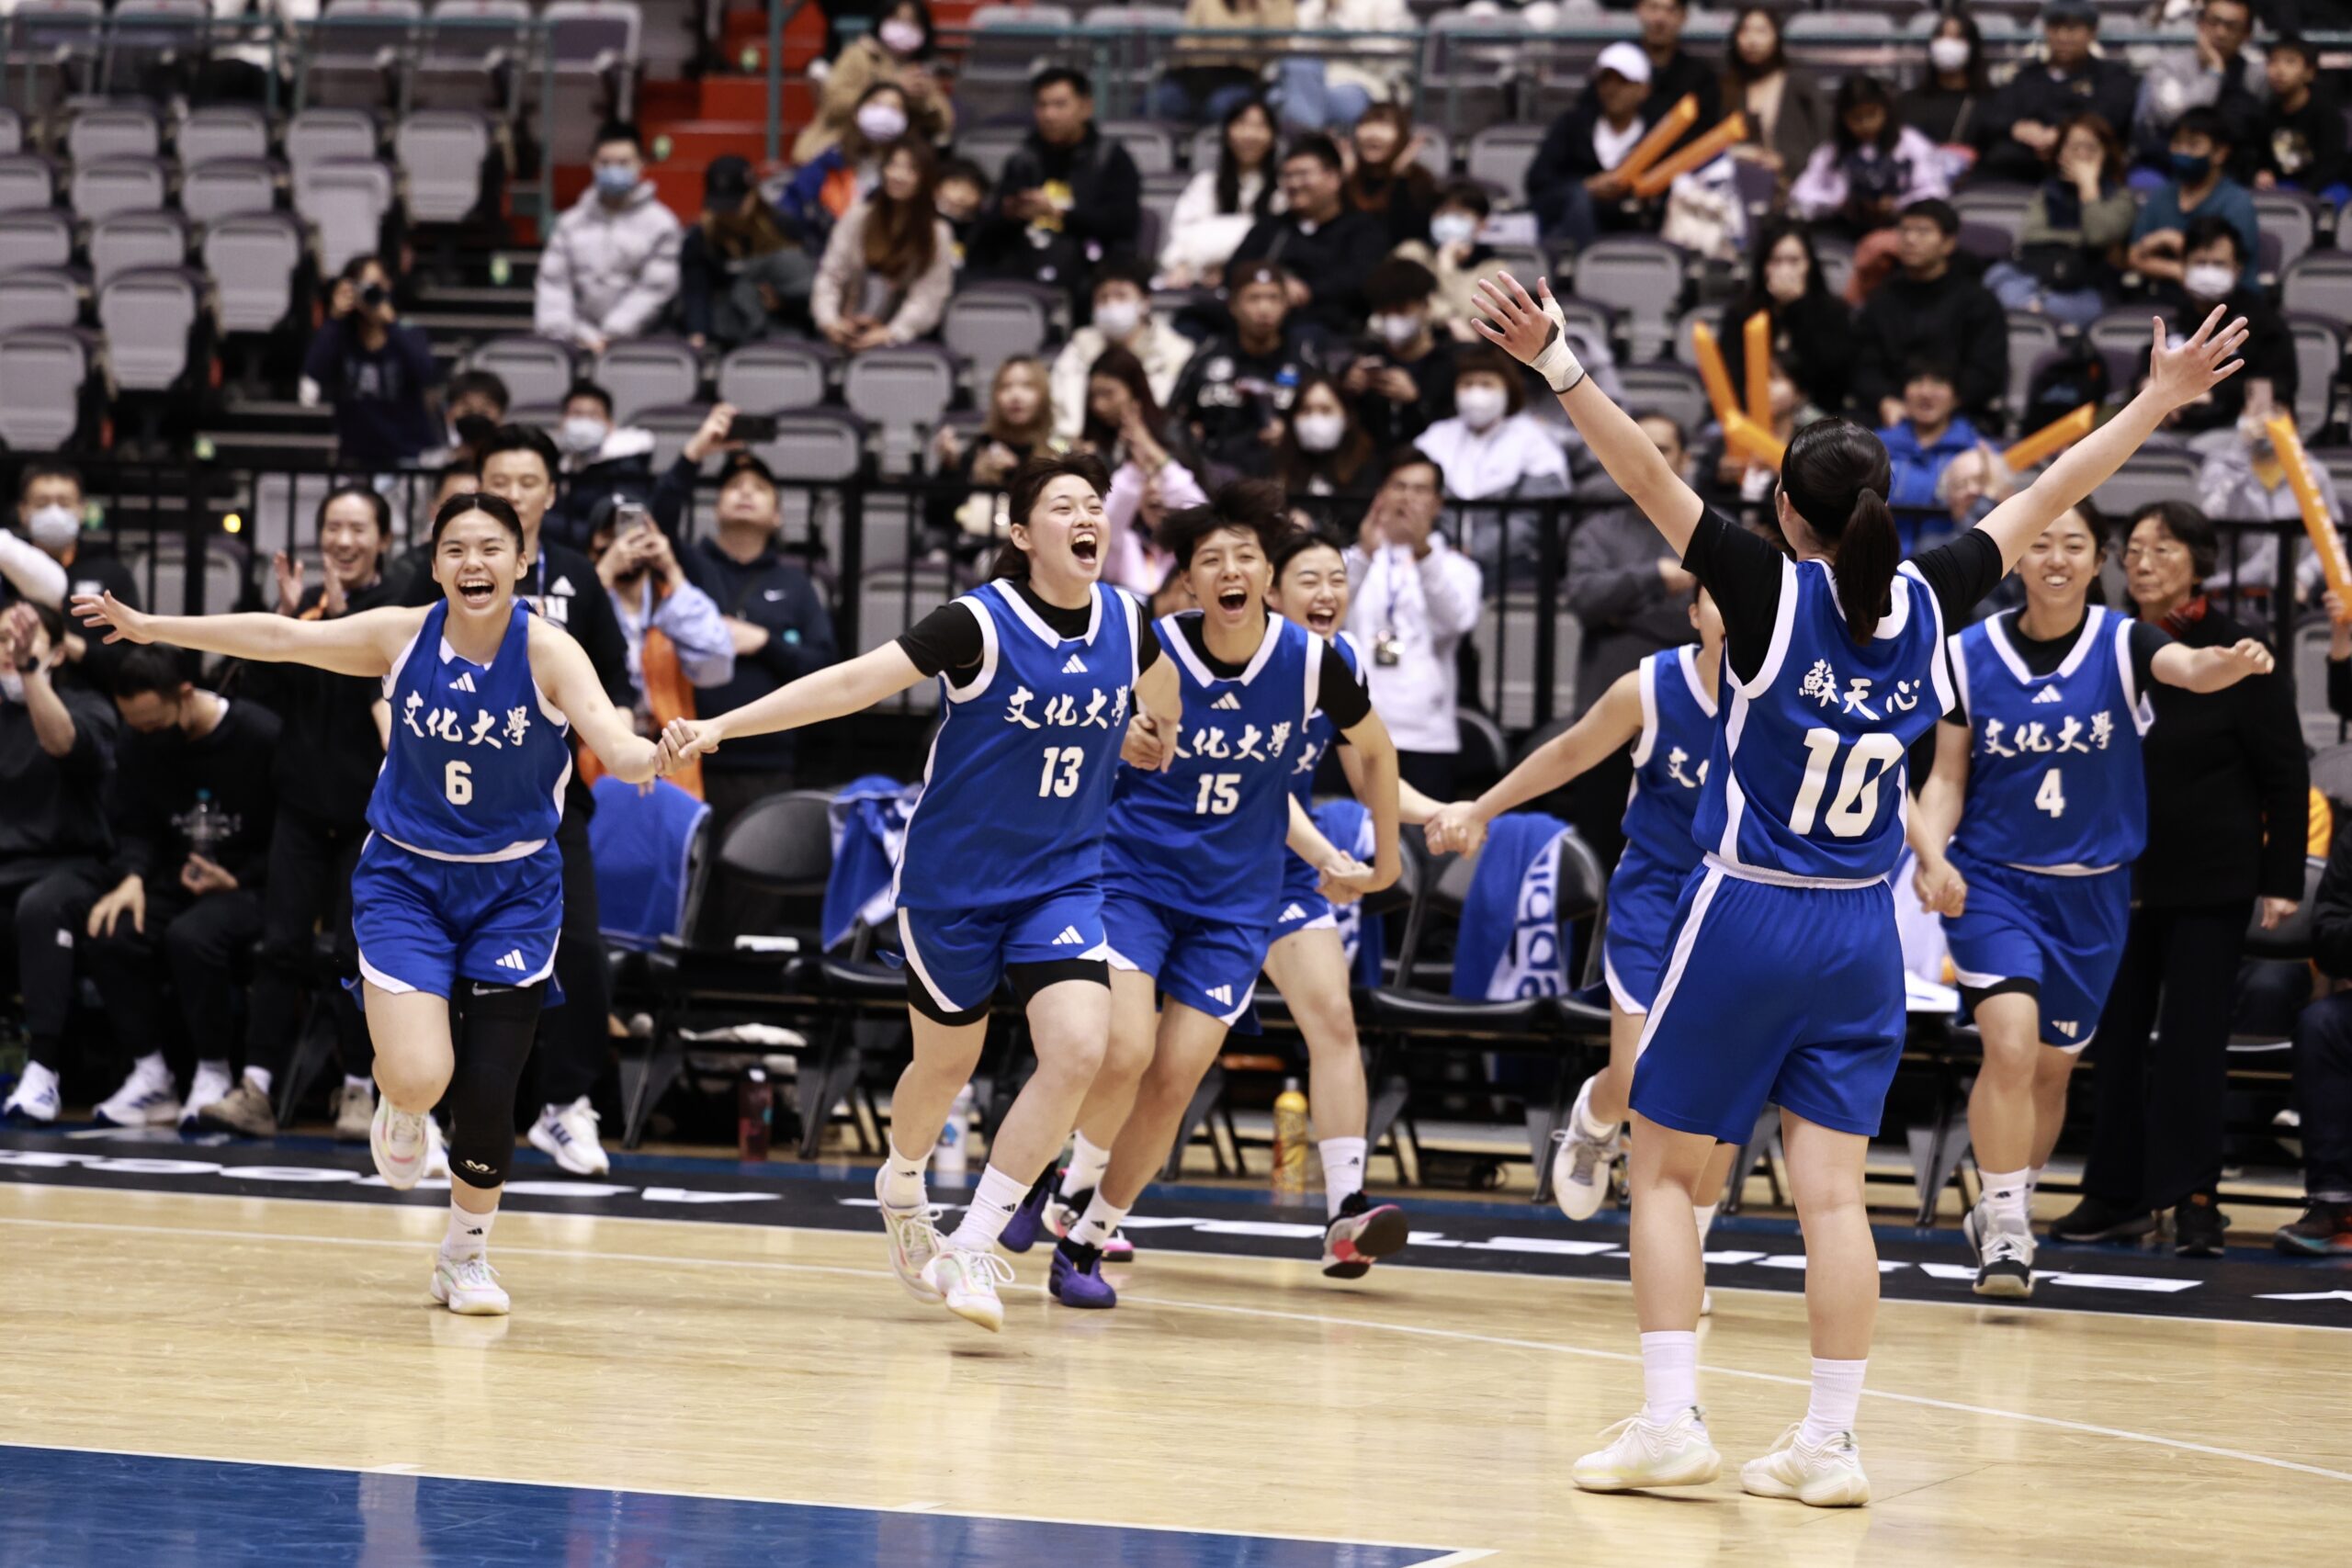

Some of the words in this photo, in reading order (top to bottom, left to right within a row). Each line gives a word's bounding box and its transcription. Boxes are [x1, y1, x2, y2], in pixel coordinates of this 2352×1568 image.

[1003, 685, 1128, 729] 文化大學
[1799, 659, 1920, 720] 蘇天心
[402, 690, 531, 750] 文化大學
[1984, 710, 2115, 758] 文化大學
[445, 760, 473, 806] 6
[1038, 746, 1084, 797] 13
[1195, 773, 1241, 815] 15
[1789, 727, 1905, 837] 10
[2034, 768, 2066, 818] 4
